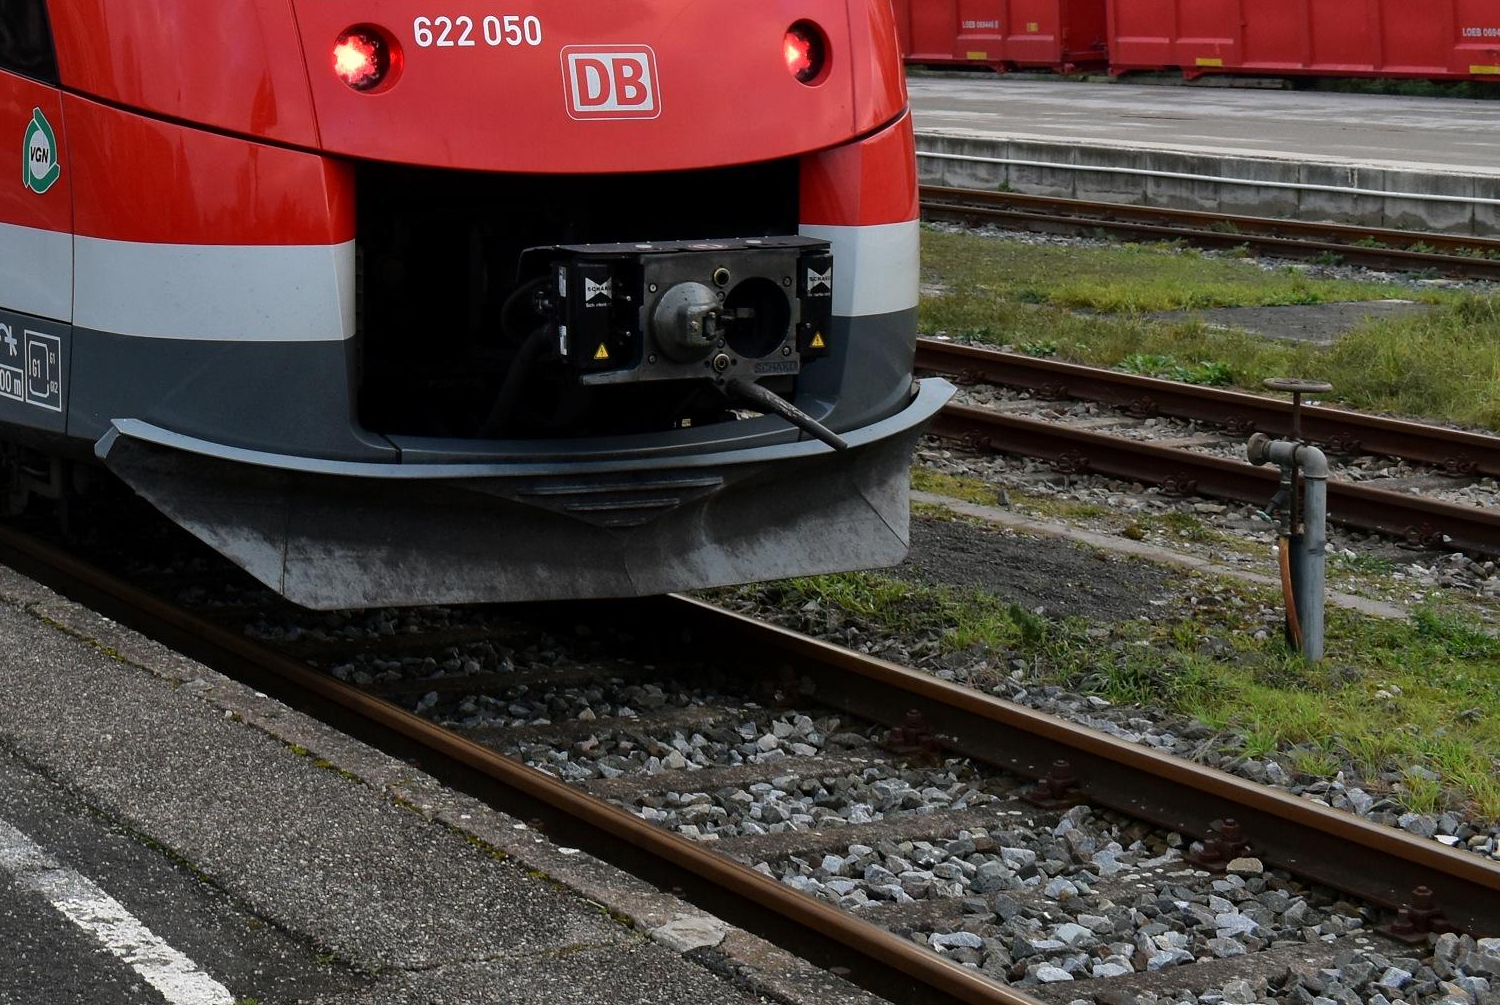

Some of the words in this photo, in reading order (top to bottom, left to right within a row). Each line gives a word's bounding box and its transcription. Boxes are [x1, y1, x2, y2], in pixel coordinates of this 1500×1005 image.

[413, 15, 476, 47] 622
[483, 14, 542, 47] 050
[1463, 27, 1482, 37] LOEB
[573, 56, 650, 108] DB
[30, 147, 49, 164] VGN
[32, 358, 41, 378] G1
[13, 377, 22, 396] m
